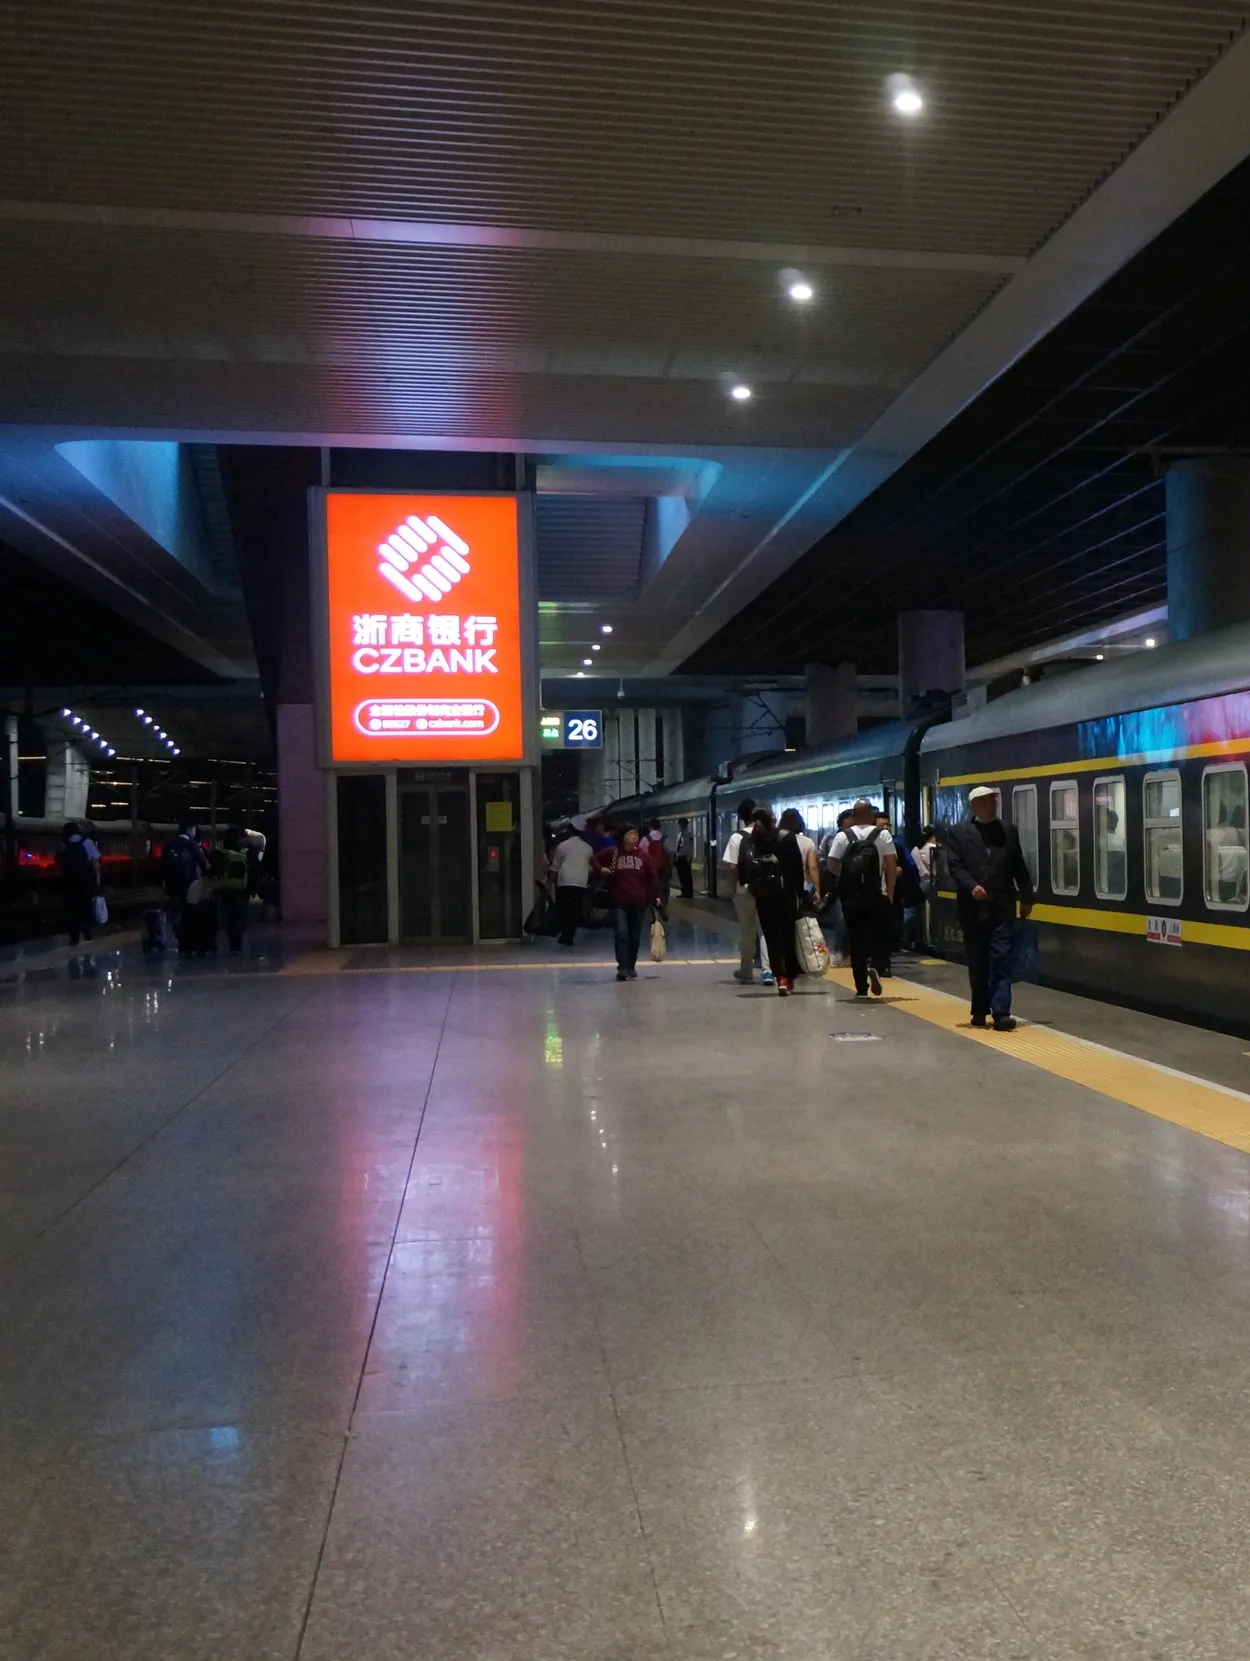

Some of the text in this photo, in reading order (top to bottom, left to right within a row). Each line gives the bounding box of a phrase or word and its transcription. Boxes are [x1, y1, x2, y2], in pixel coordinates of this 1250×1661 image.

[353, 613, 498, 646] 浙商银行
[353, 648, 498, 674] CZBANK
[568, 719, 598, 741] 26
